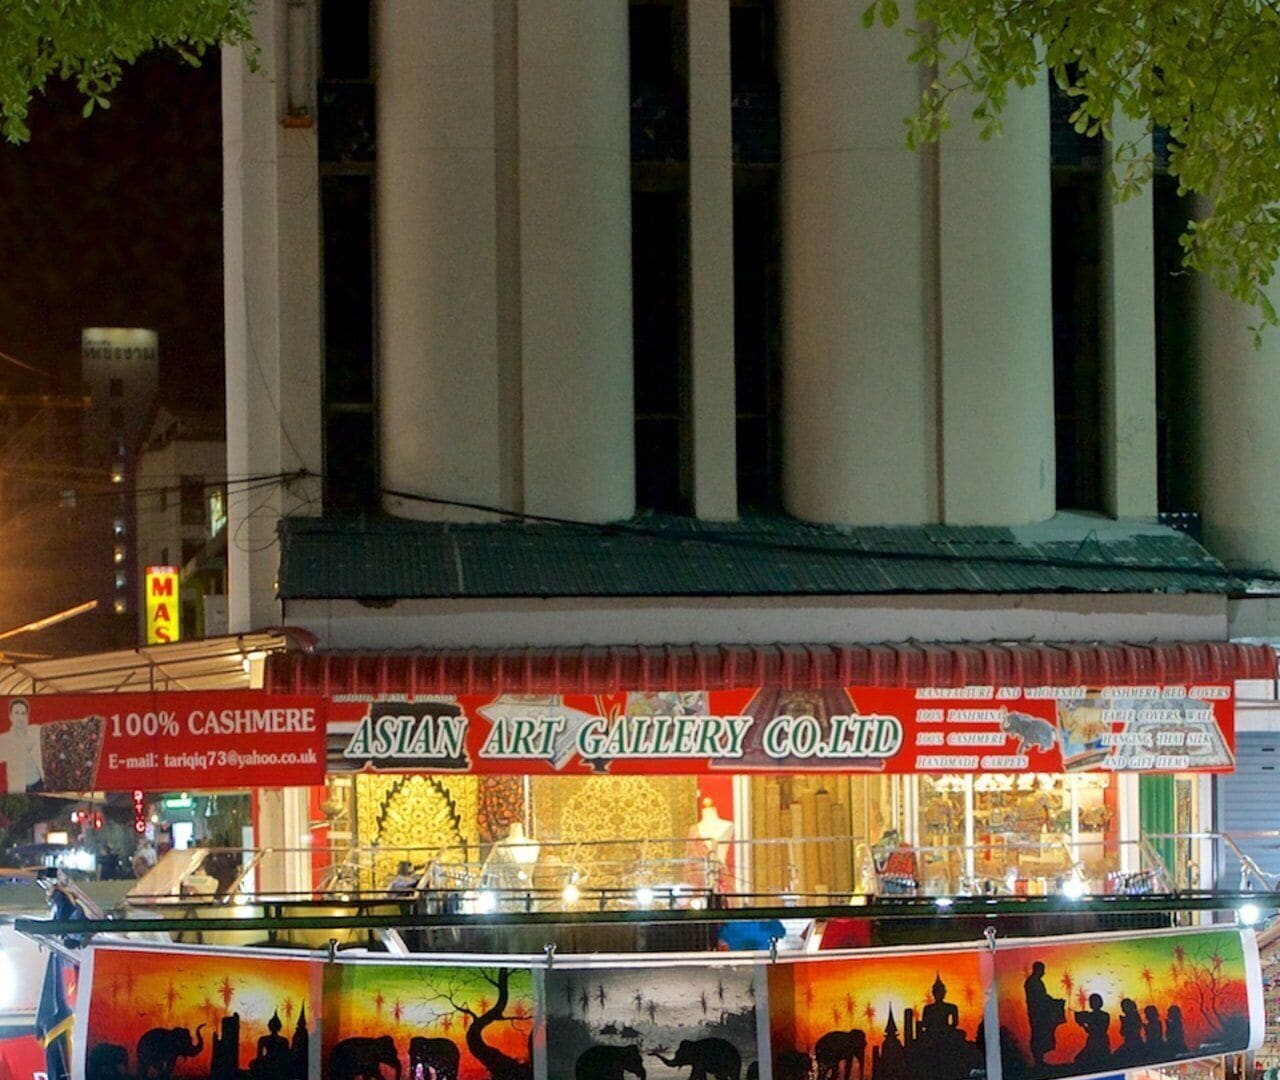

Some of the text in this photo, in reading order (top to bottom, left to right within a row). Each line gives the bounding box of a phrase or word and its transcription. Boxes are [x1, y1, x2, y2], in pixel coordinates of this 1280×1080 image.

[111, 707, 317, 738] 100% CASHMERE
[344, 715, 469, 759] ASIAN
[479, 715, 567, 759] ART
[576, 715, 754, 759] GALLERY
